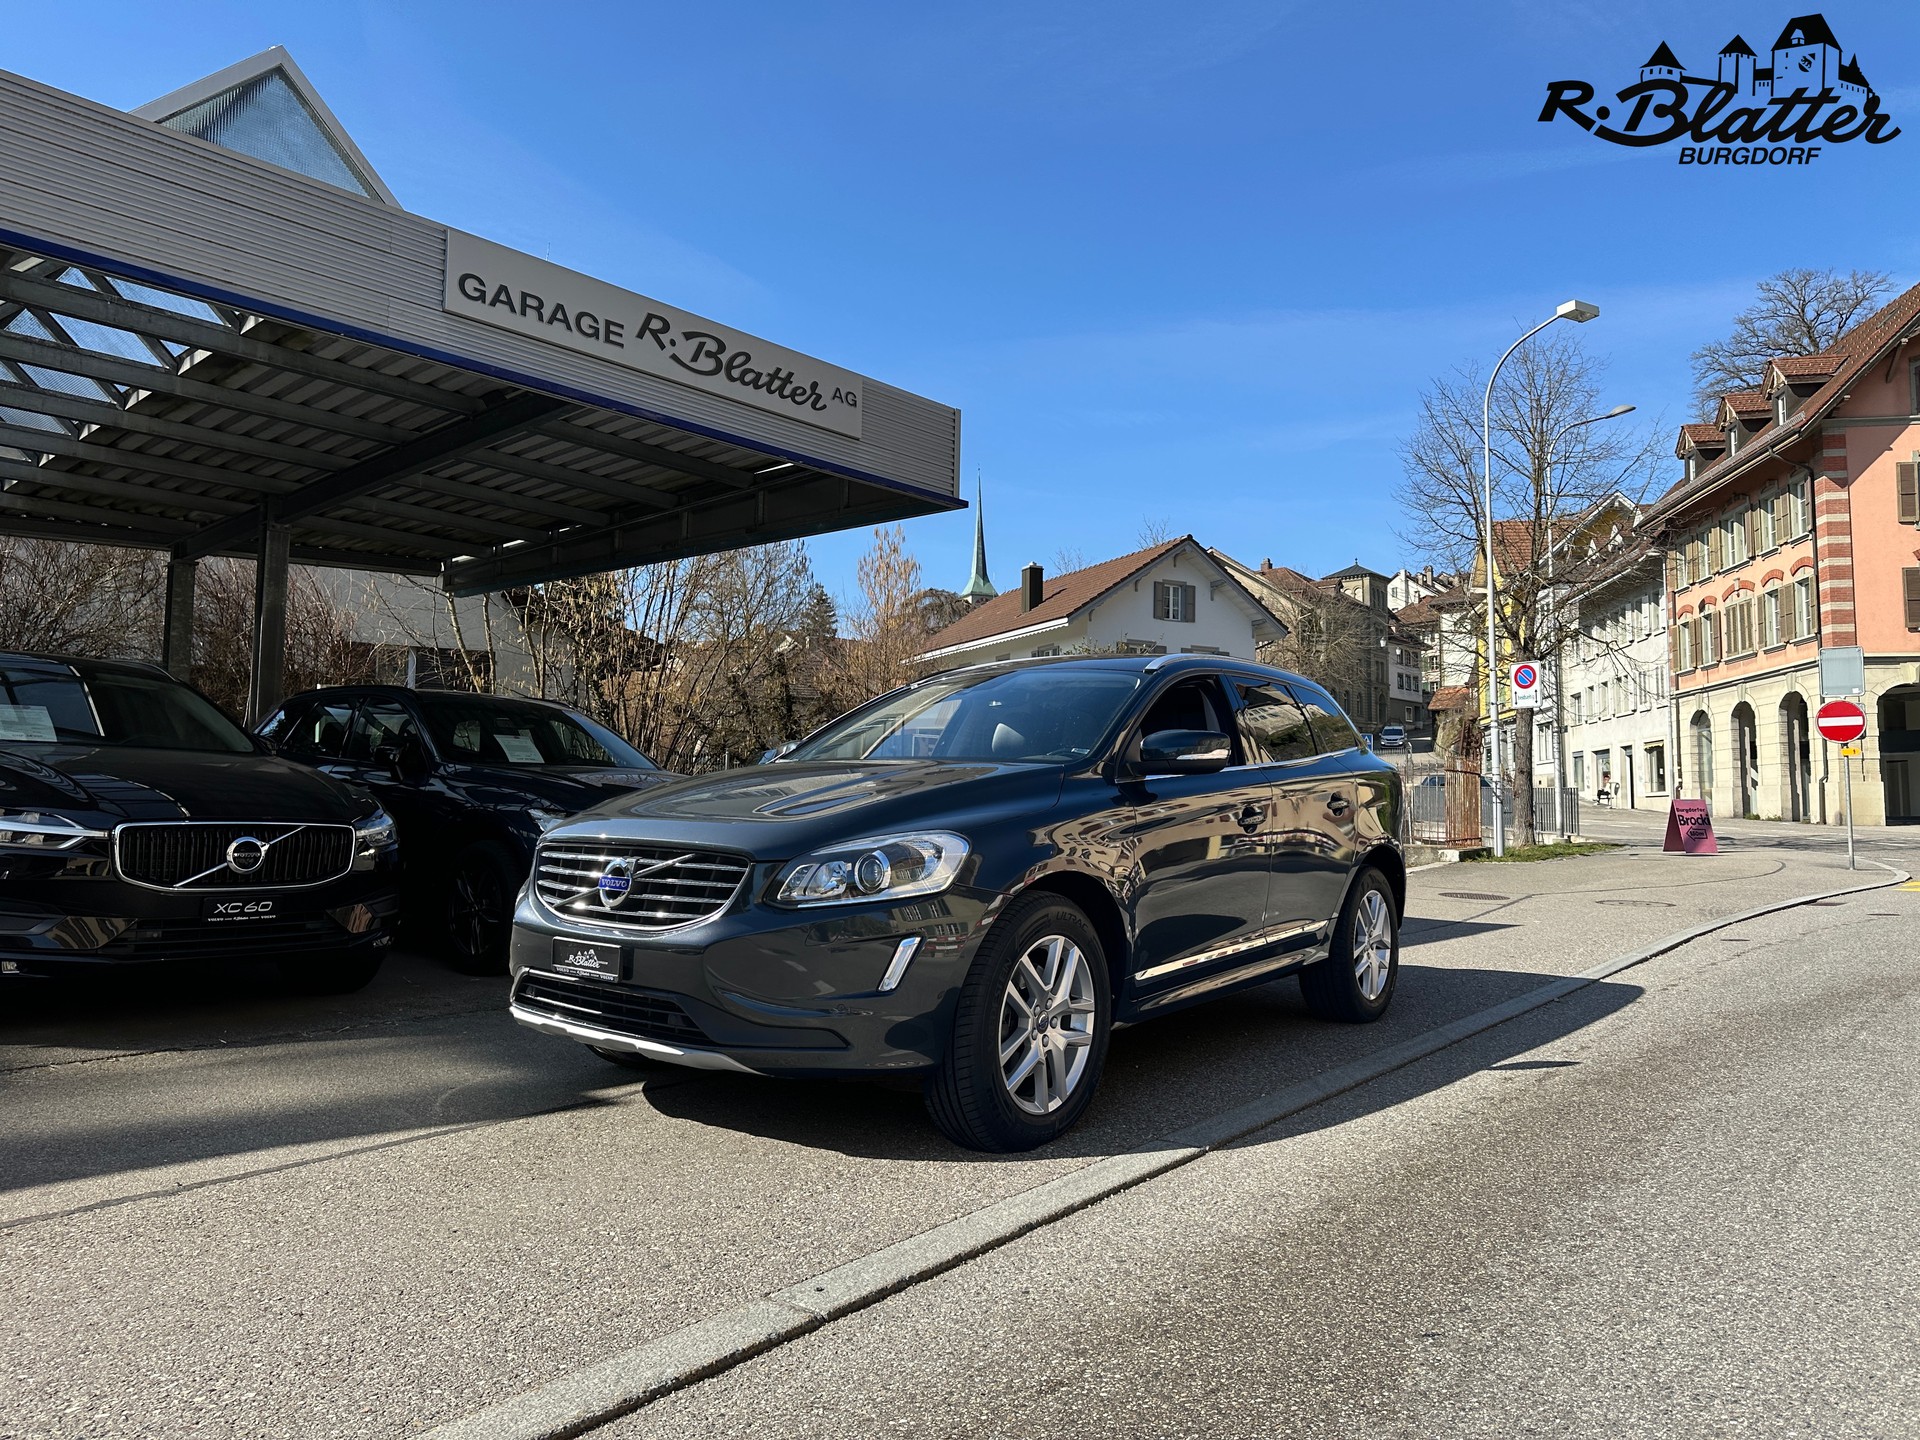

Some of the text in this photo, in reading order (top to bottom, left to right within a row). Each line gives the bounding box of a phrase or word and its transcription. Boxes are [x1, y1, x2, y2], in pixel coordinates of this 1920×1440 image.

[458, 273, 624, 348] GARAGE
[832, 386, 858, 408] AG
[1678, 814, 1711, 826] Brocki
[601, 878, 628, 888] VOLVO
